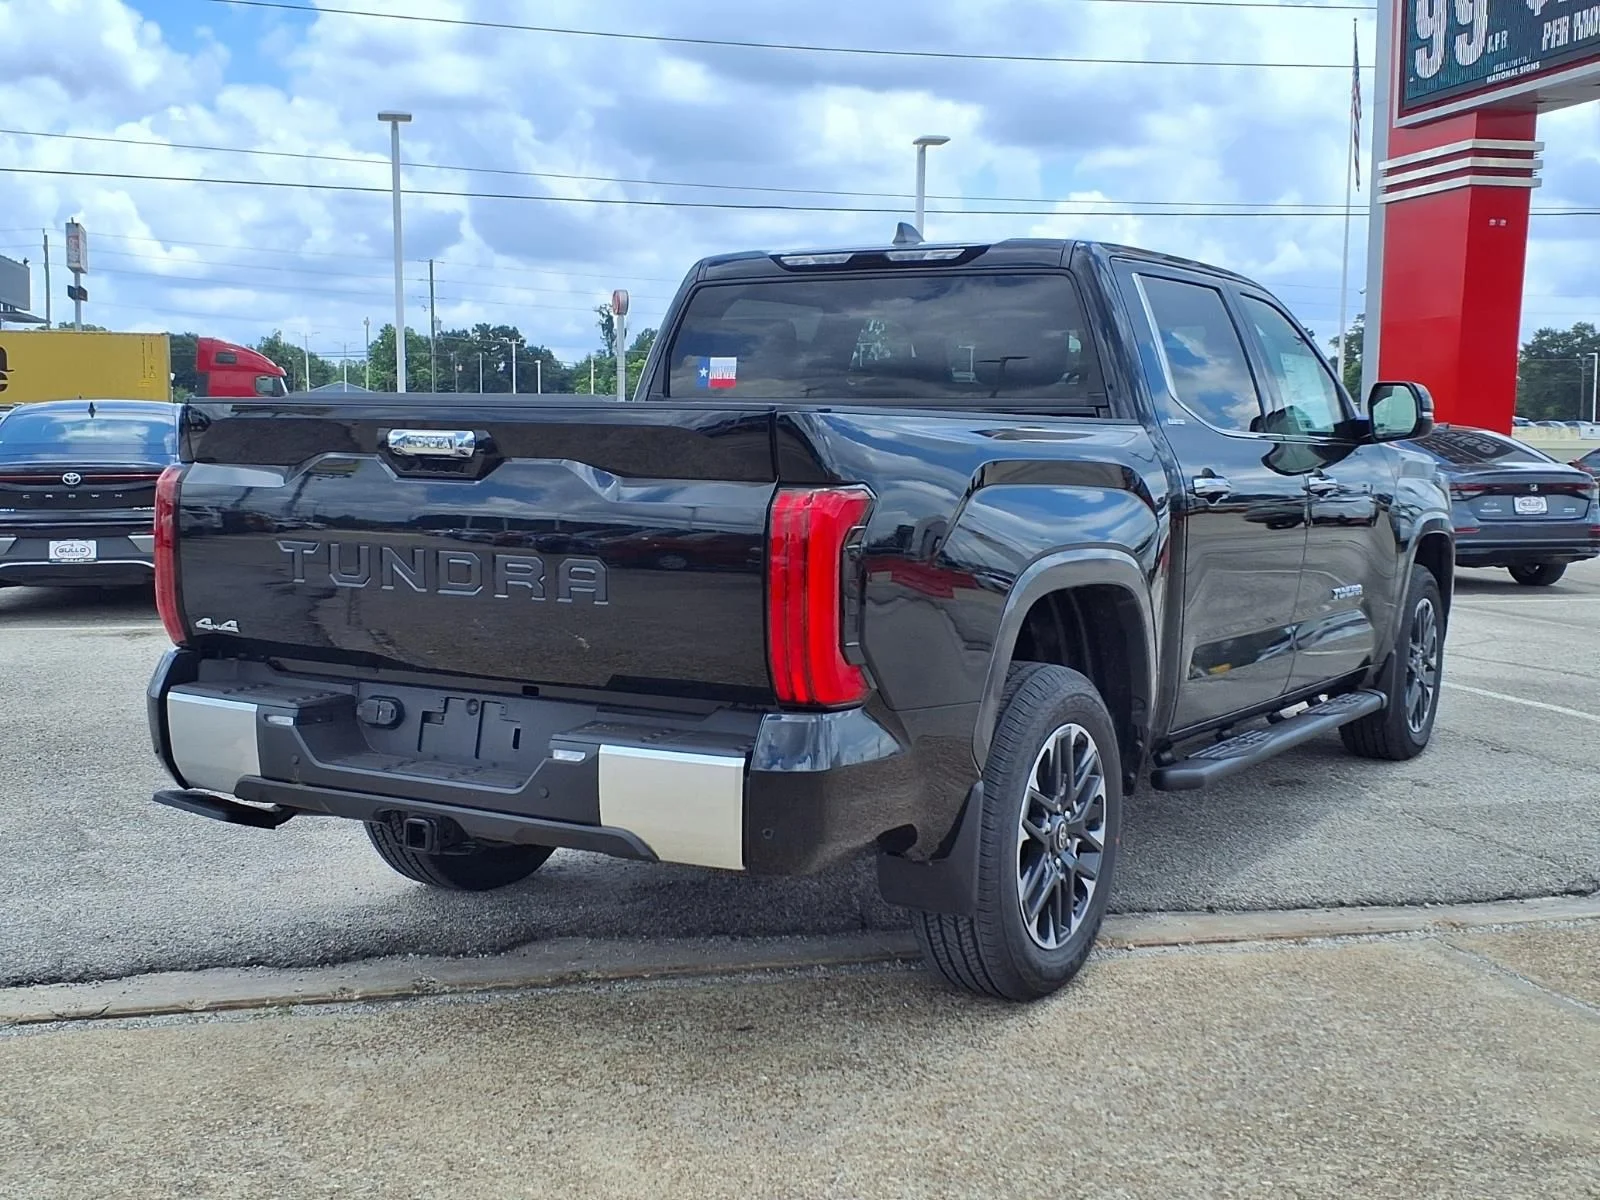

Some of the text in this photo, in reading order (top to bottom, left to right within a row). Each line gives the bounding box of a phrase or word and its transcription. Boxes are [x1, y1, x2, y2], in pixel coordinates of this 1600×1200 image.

[1486, 67, 1519, 84] NATIONAL
[1519, 61, 1541, 74] SIGNS
[277, 540, 608, 605] TUNDRA
